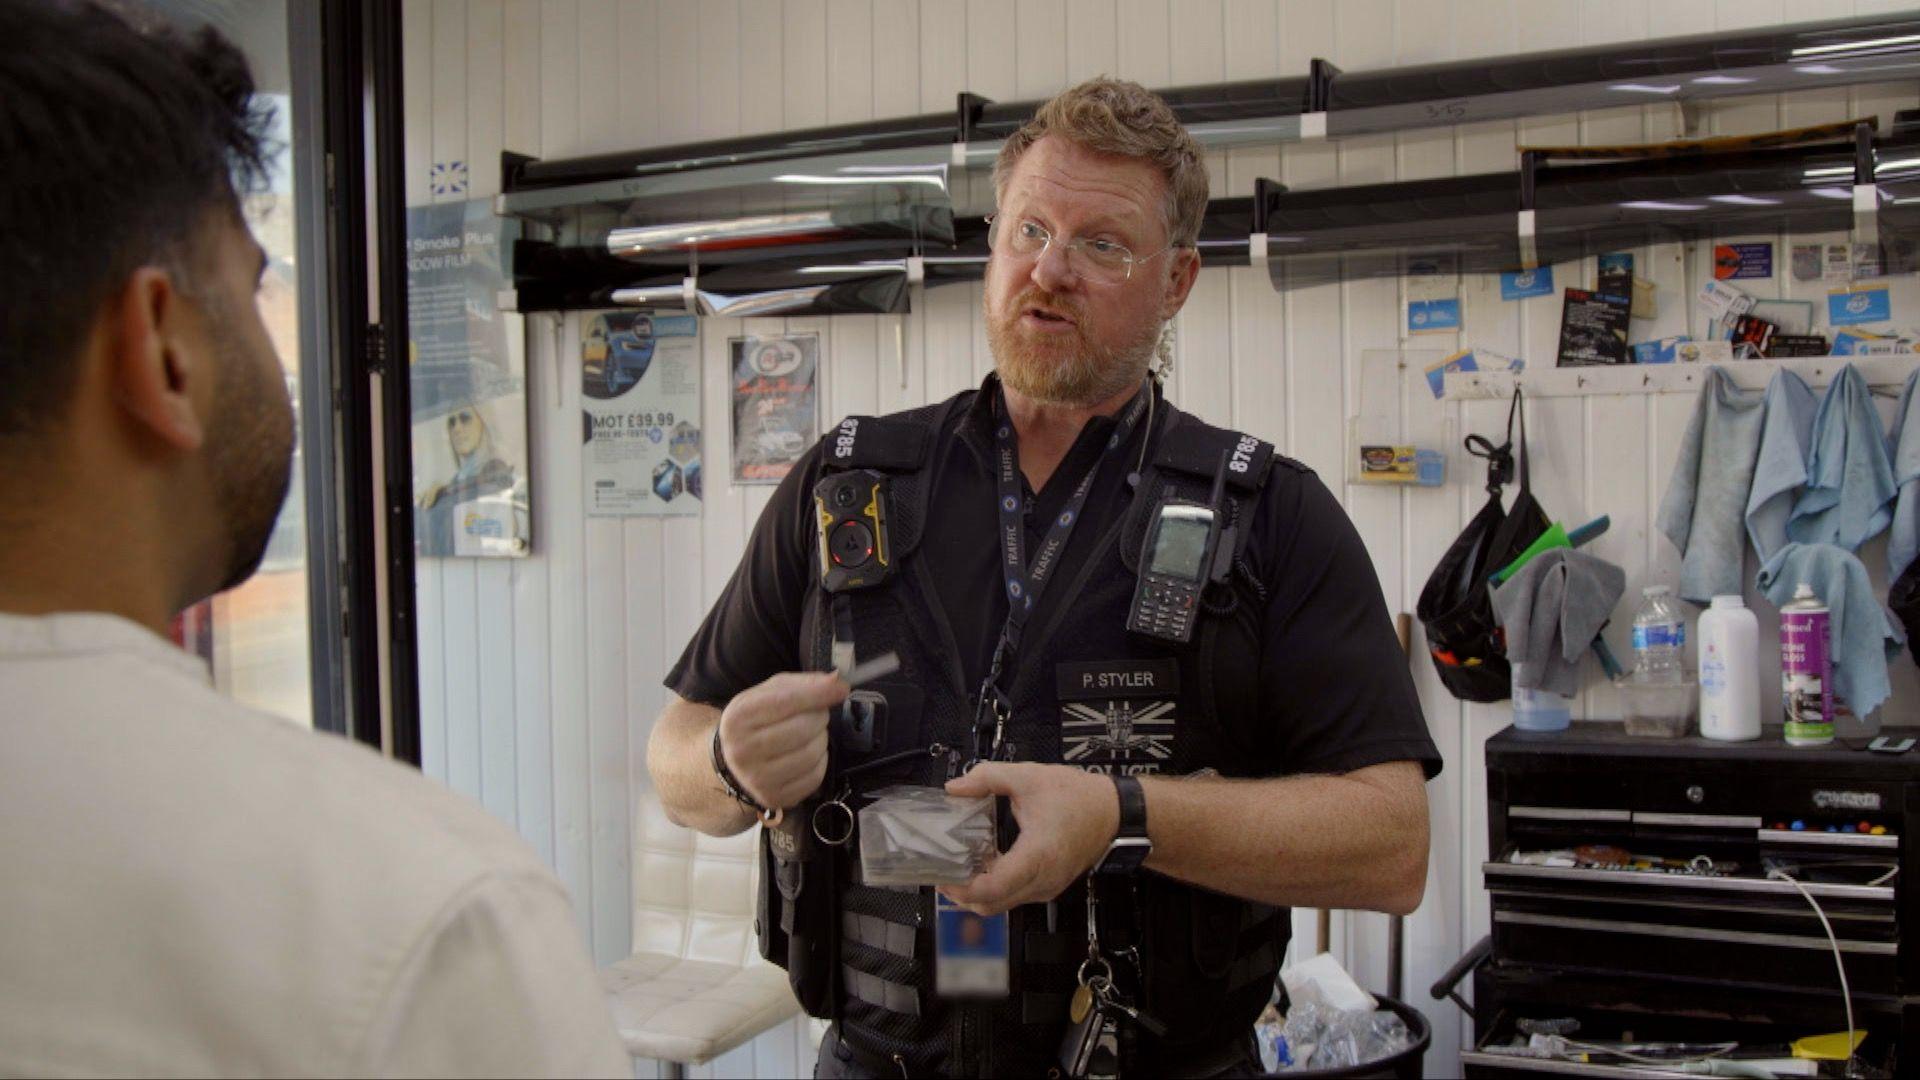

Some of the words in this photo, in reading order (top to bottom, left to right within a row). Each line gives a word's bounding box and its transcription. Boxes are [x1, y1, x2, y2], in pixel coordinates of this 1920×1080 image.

[414, 236, 460, 253] Smoke
[465, 232, 496, 245] Plus
[593, 415, 624, 429] MOT
[628, 411, 675, 428] £39.99
[835, 418, 859, 458] 8785
[1229, 435, 1259, 473] 8785
[1006, 525, 1017, 565] TRAFFIC
[1031, 540, 1060, 581] TRAFFIC
[1083, 672, 1095, 688] P.
[1099, 671, 1154, 687] STYLER
[1080, 763, 1160, 777] OLICE
